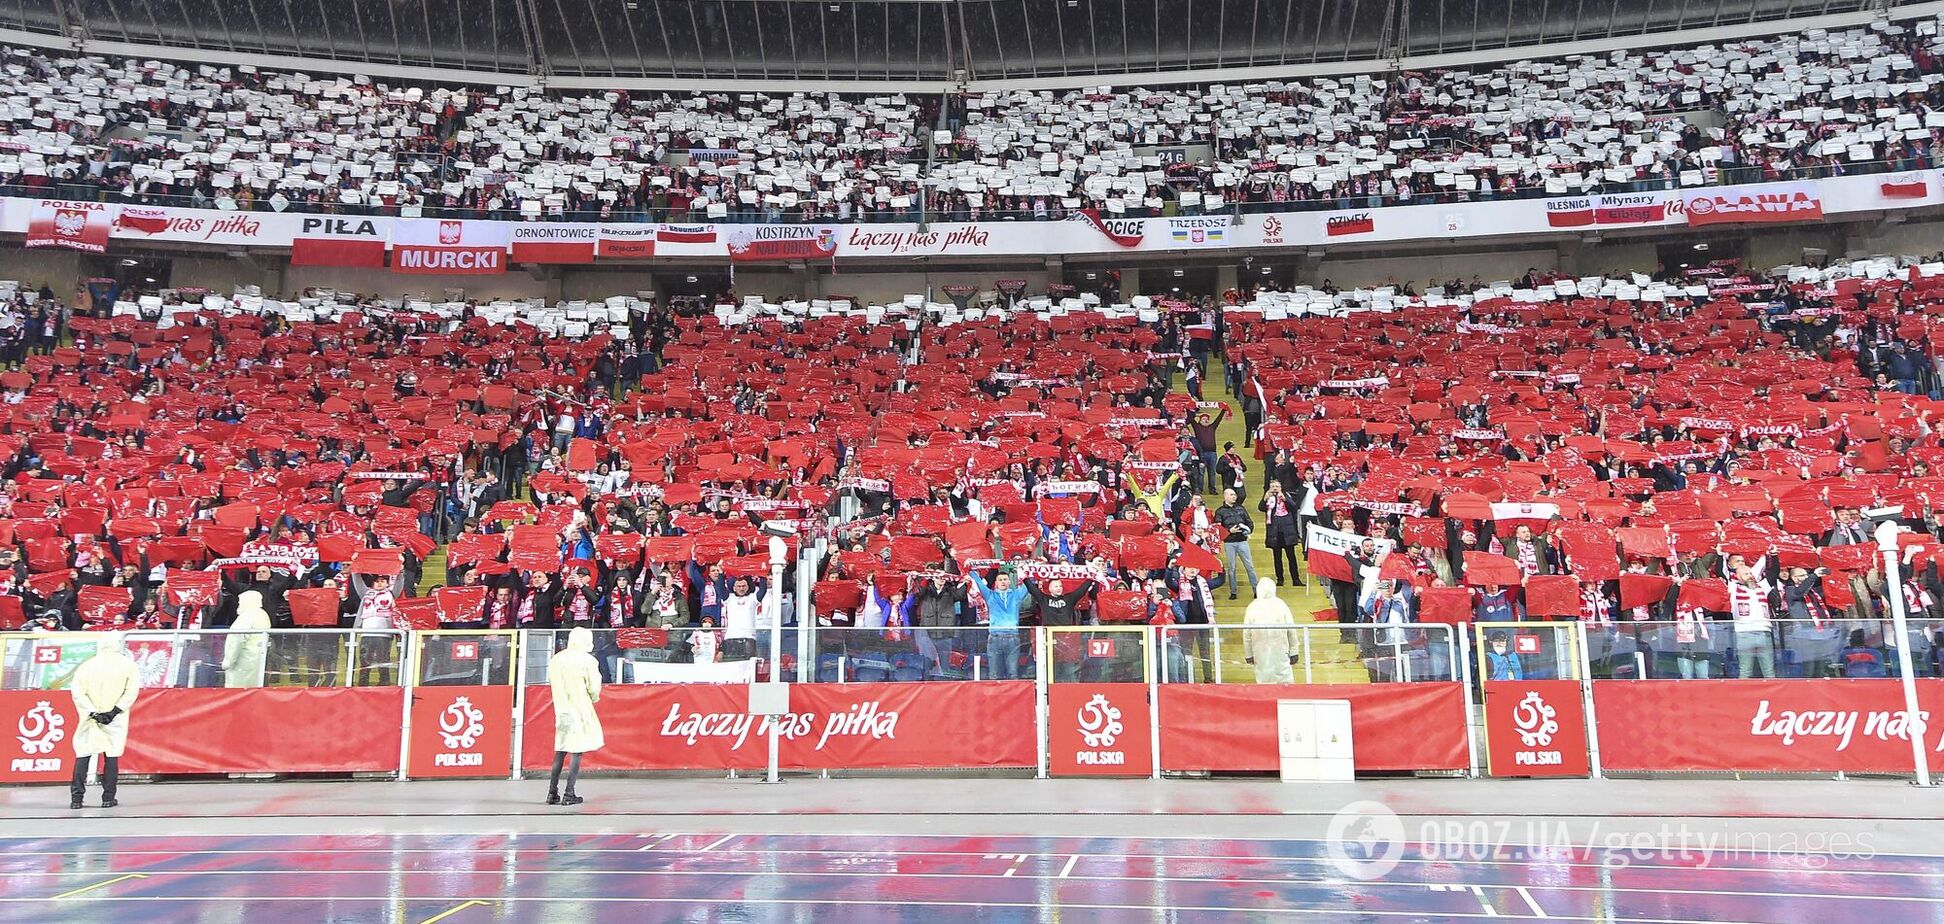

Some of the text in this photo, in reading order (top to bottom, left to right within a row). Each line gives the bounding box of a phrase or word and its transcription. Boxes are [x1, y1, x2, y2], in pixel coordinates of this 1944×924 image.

[1158, 151, 1173, 164] 24
[41, 200, 105, 212] POLSKA
[1547, 199, 1591, 210] OLEŚNICA
[1601, 194, 1655, 206] Młynary
[122, 207, 166, 216] POLSKA
[166, 216, 204, 233] nas
[204, 215, 261, 240] piłka
[302, 218, 377, 236] PIŁA
[1169, 219, 1227, 229] TRZEBOSZ
[1328, 212, 1370, 229] OZIMEK
[515, 227, 595, 239] ORNONTOWICE
[755, 226, 815, 240] KOSTRZYN
[849, 227, 990, 253] Łączy nas piłka
[26, 238, 105, 252] NOWA SARZYNA
[401, 250, 498, 269] MURCKI
[1196, 401, 1219, 409] POLSKA
[1748, 424, 1795, 435] POLSKA
[1028, 564, 1092, 580] POLSKA
[38, 649, 57, 662] 35
[456, 644, 474, 658] 36
[1092, 641, 1110, 656] 37
[660, 702, 752, 751] Łączy
[815, 701, 899, 751] piłka
[1751, 700, 1858, 751] Łączy
[435, 752, 483, 767] POLSKA
[1077, 751, 1125, 765] POLSKA
[1515, 750, 1562, 765] POLSKA
[11, 758, 61, 772] POLSKA
